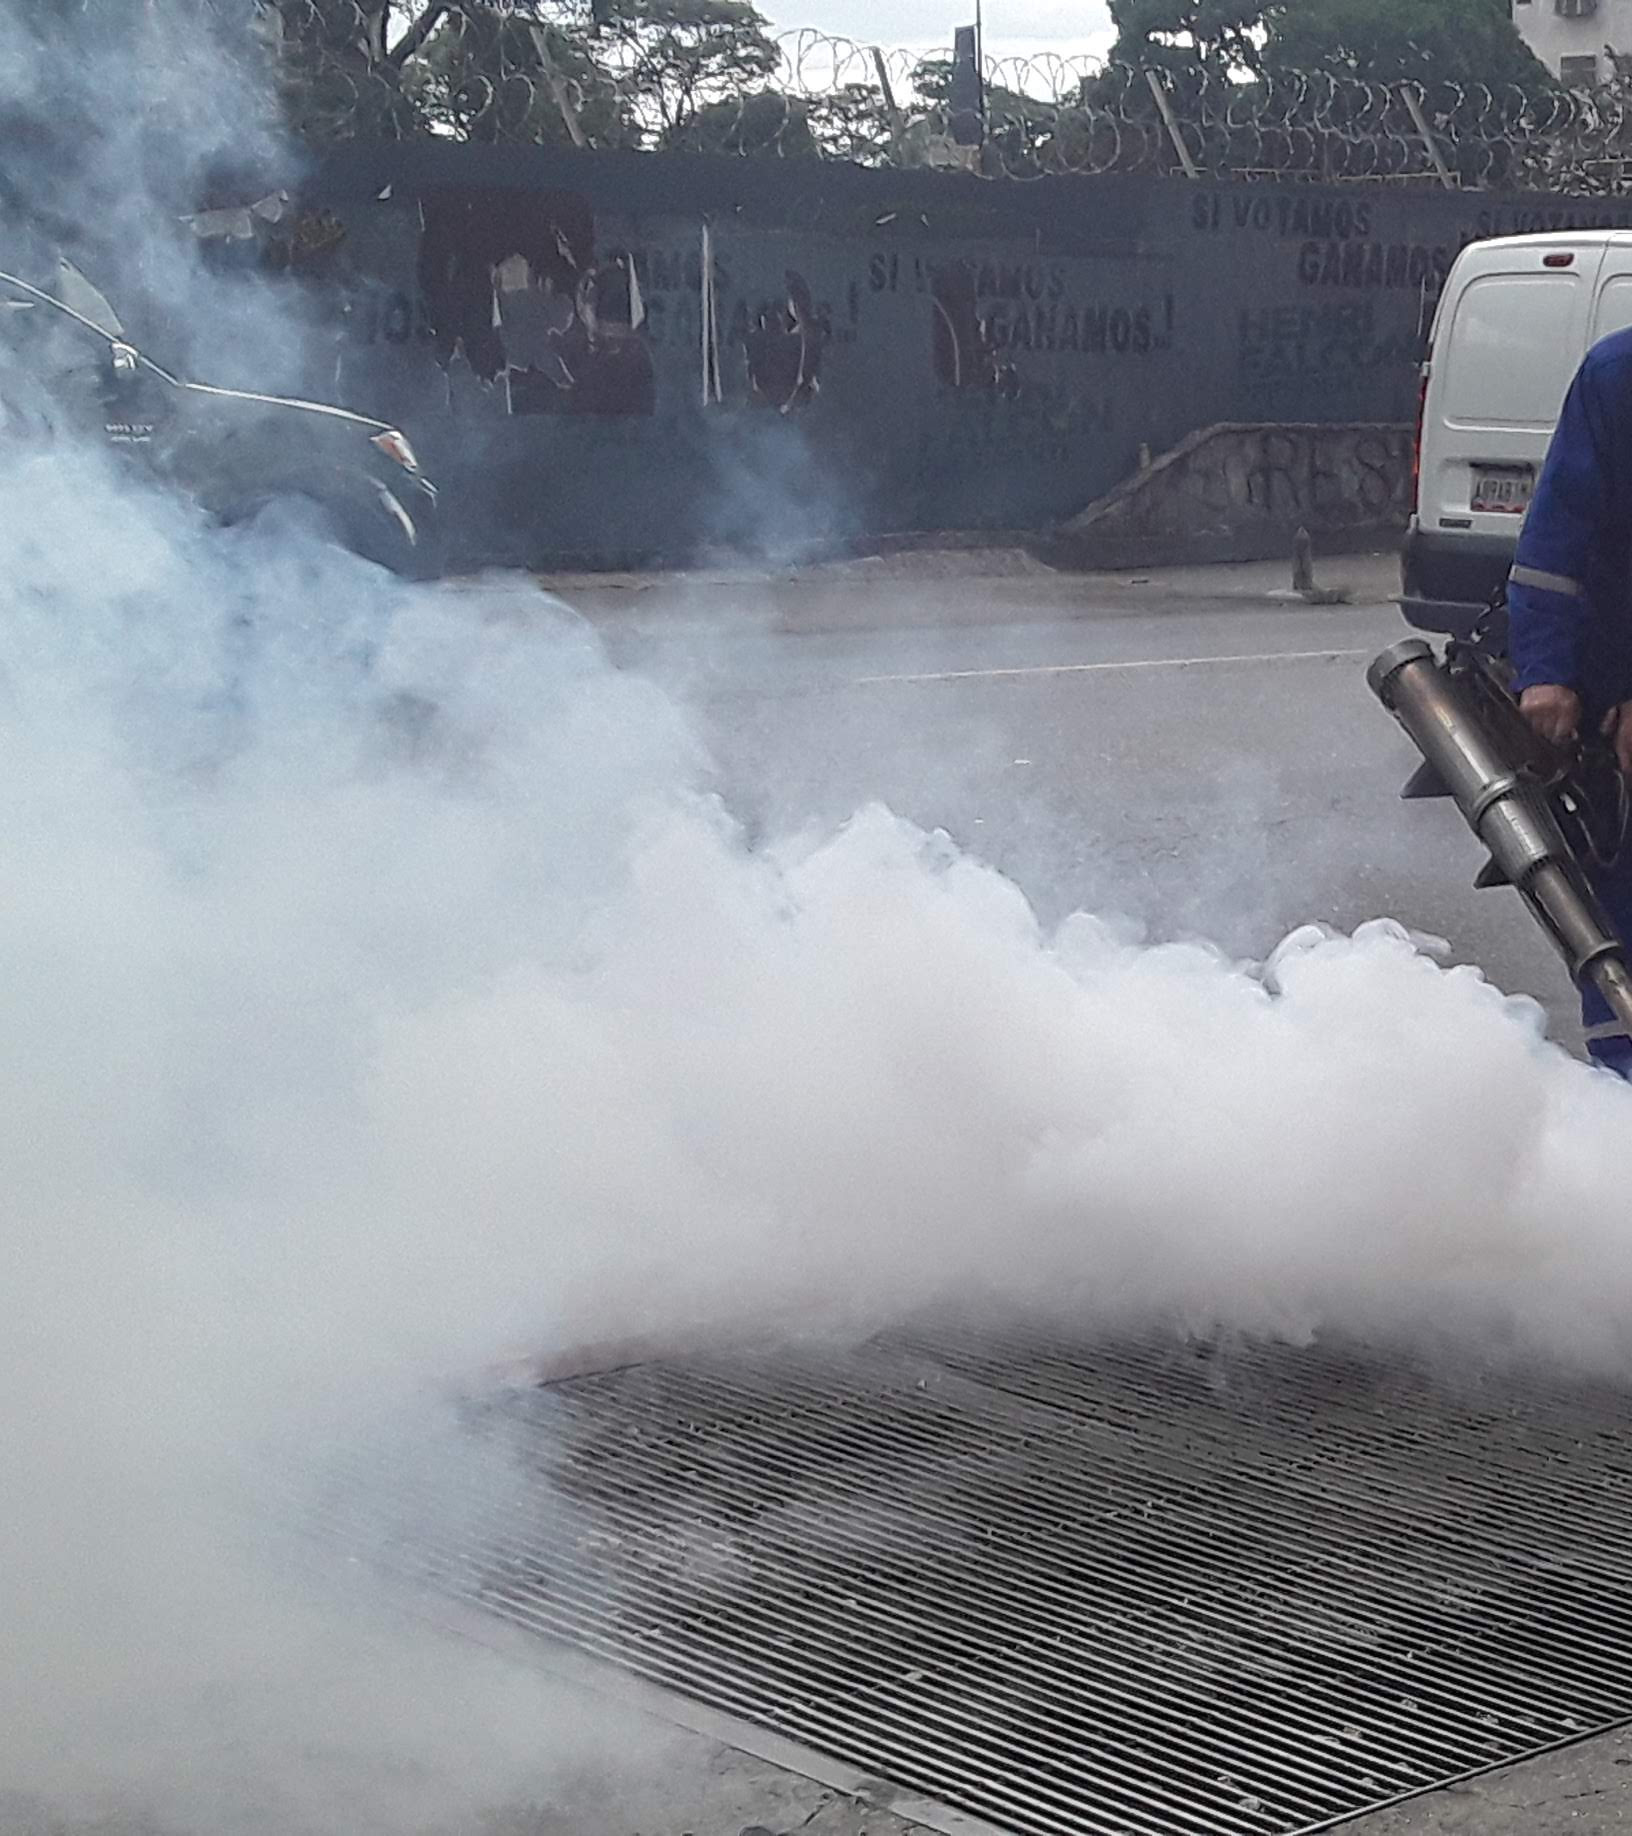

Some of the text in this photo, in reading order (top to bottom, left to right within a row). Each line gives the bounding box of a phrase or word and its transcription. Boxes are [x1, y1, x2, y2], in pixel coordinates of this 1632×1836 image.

[1191, 193, 1372, 238] SI VOTAMOS
[867, 252, 899, 292] SI
